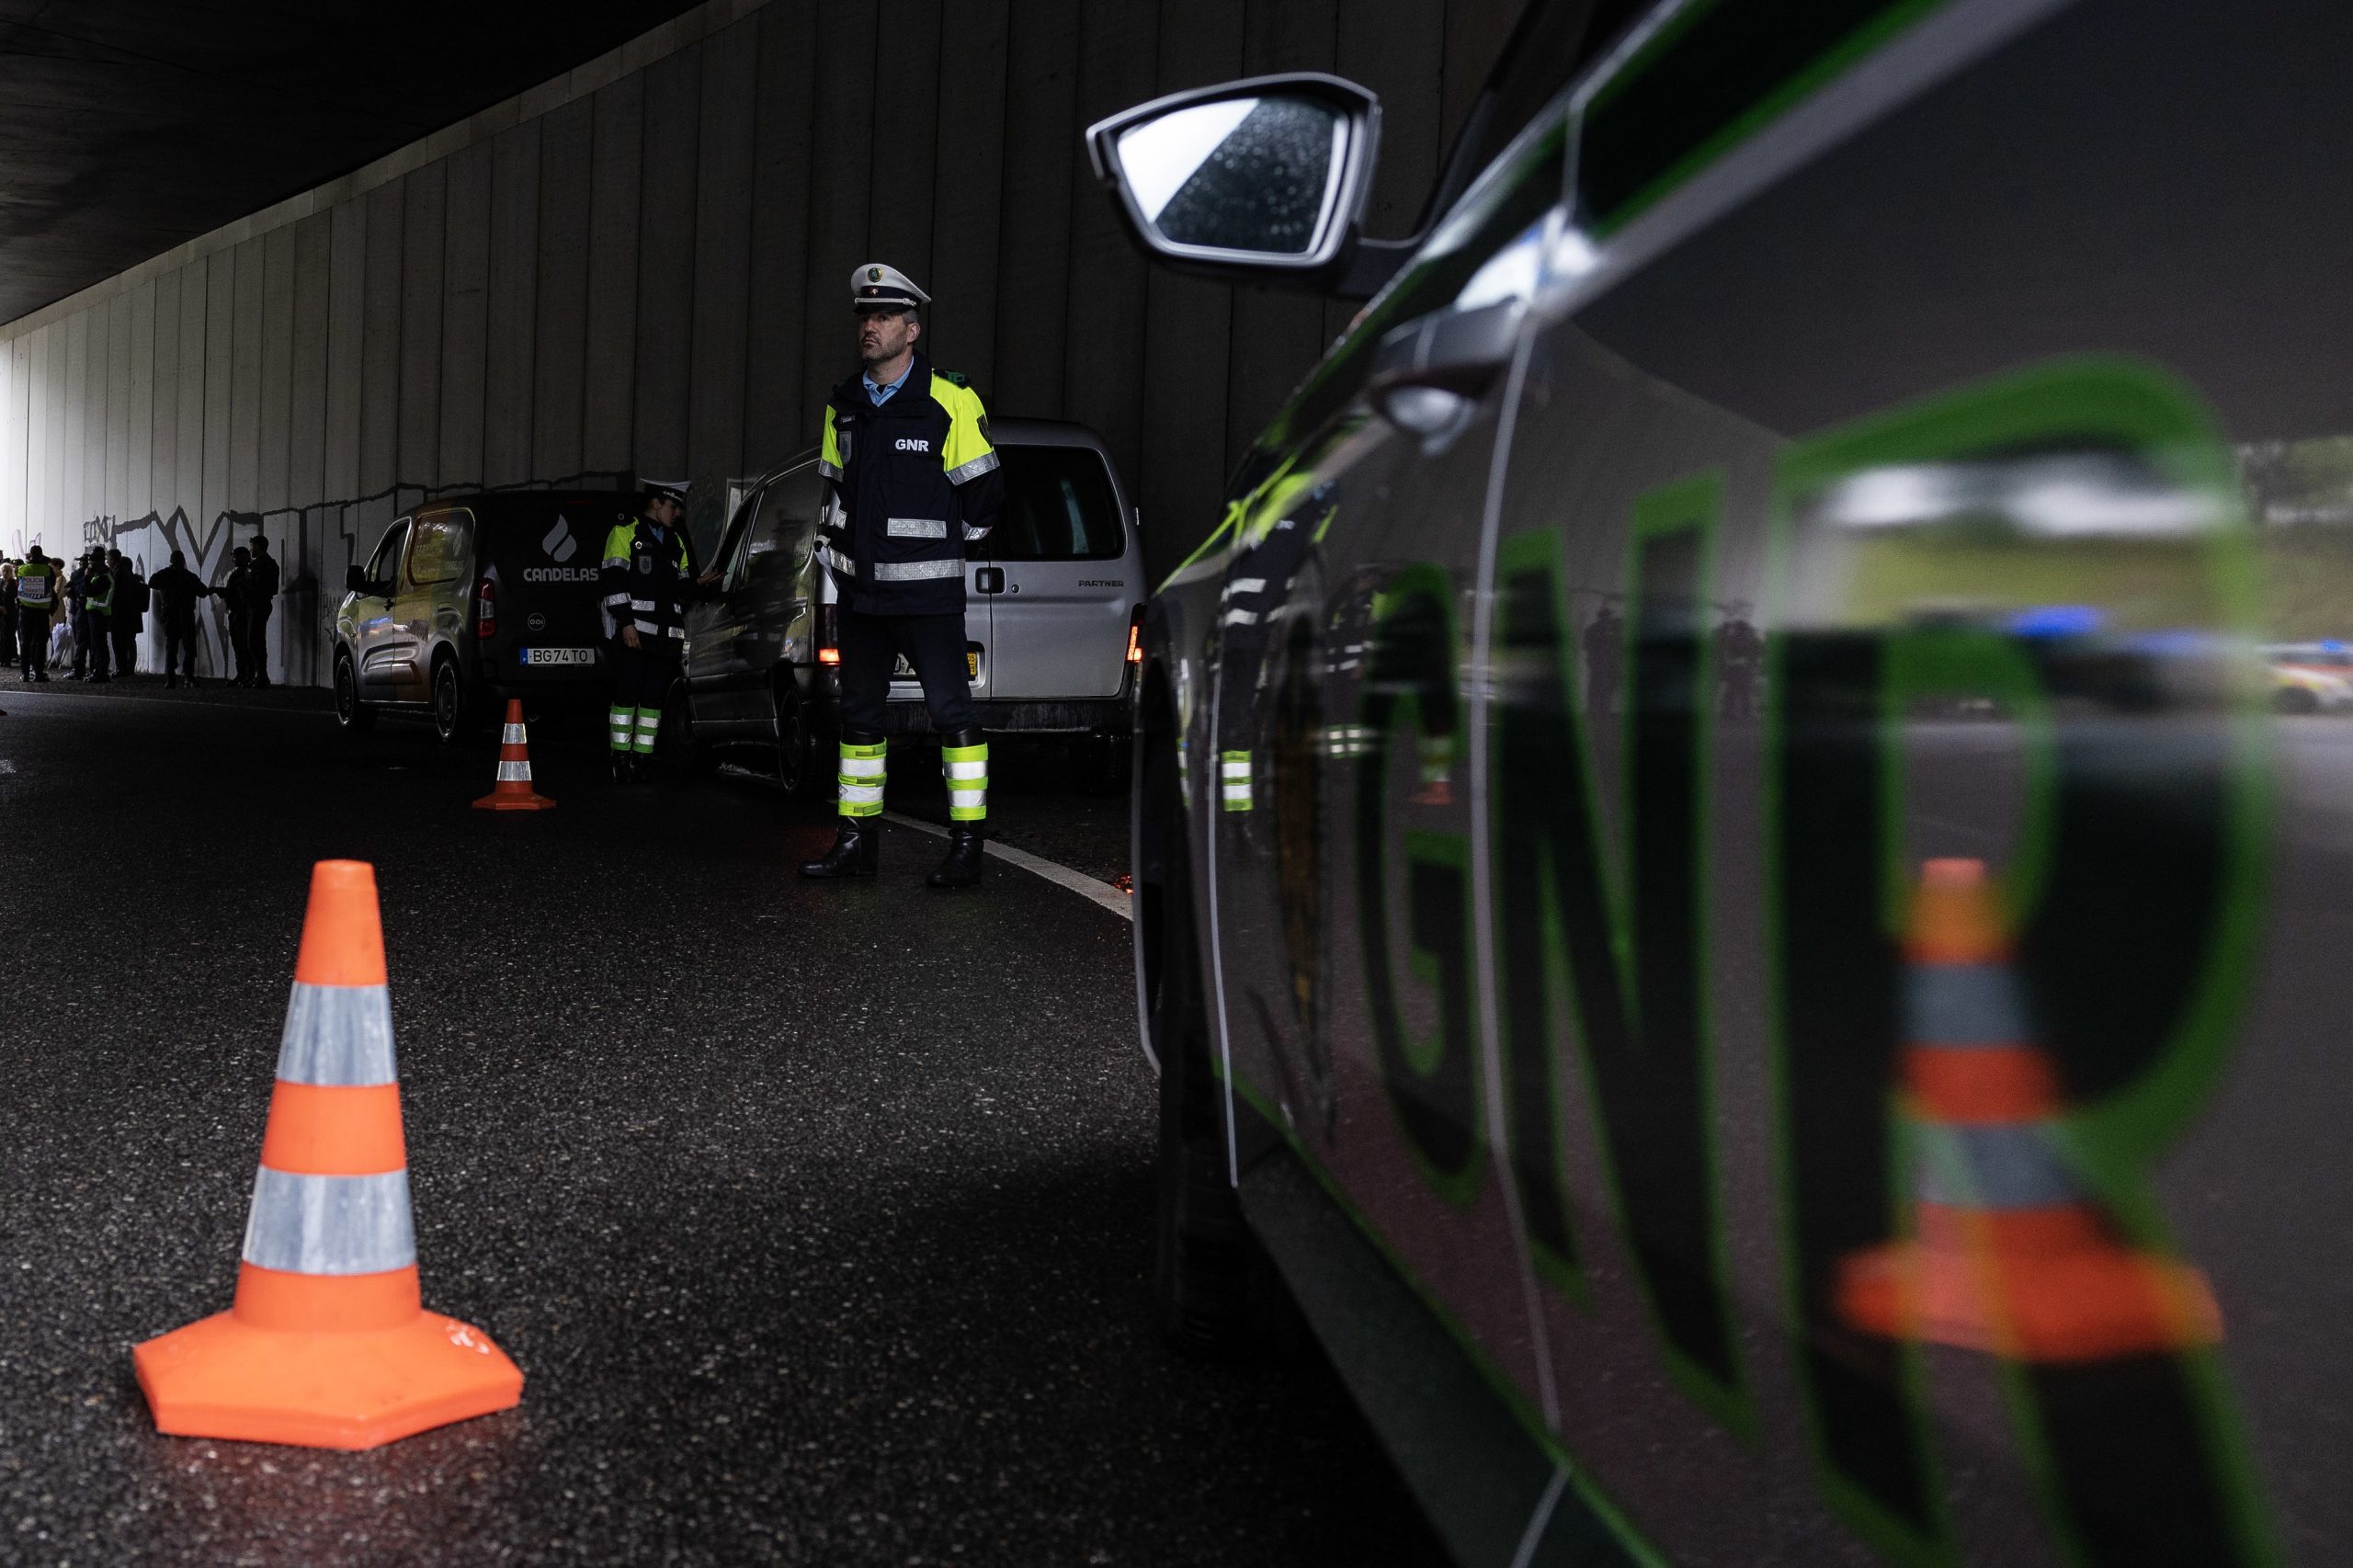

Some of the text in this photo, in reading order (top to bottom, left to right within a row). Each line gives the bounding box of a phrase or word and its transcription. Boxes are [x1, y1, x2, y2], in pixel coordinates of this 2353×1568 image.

[894, 438, 929, 452] GNR
[523, 567, 600, 582] CANDELAS
[1358, 355, 2278, 1568] GNR
